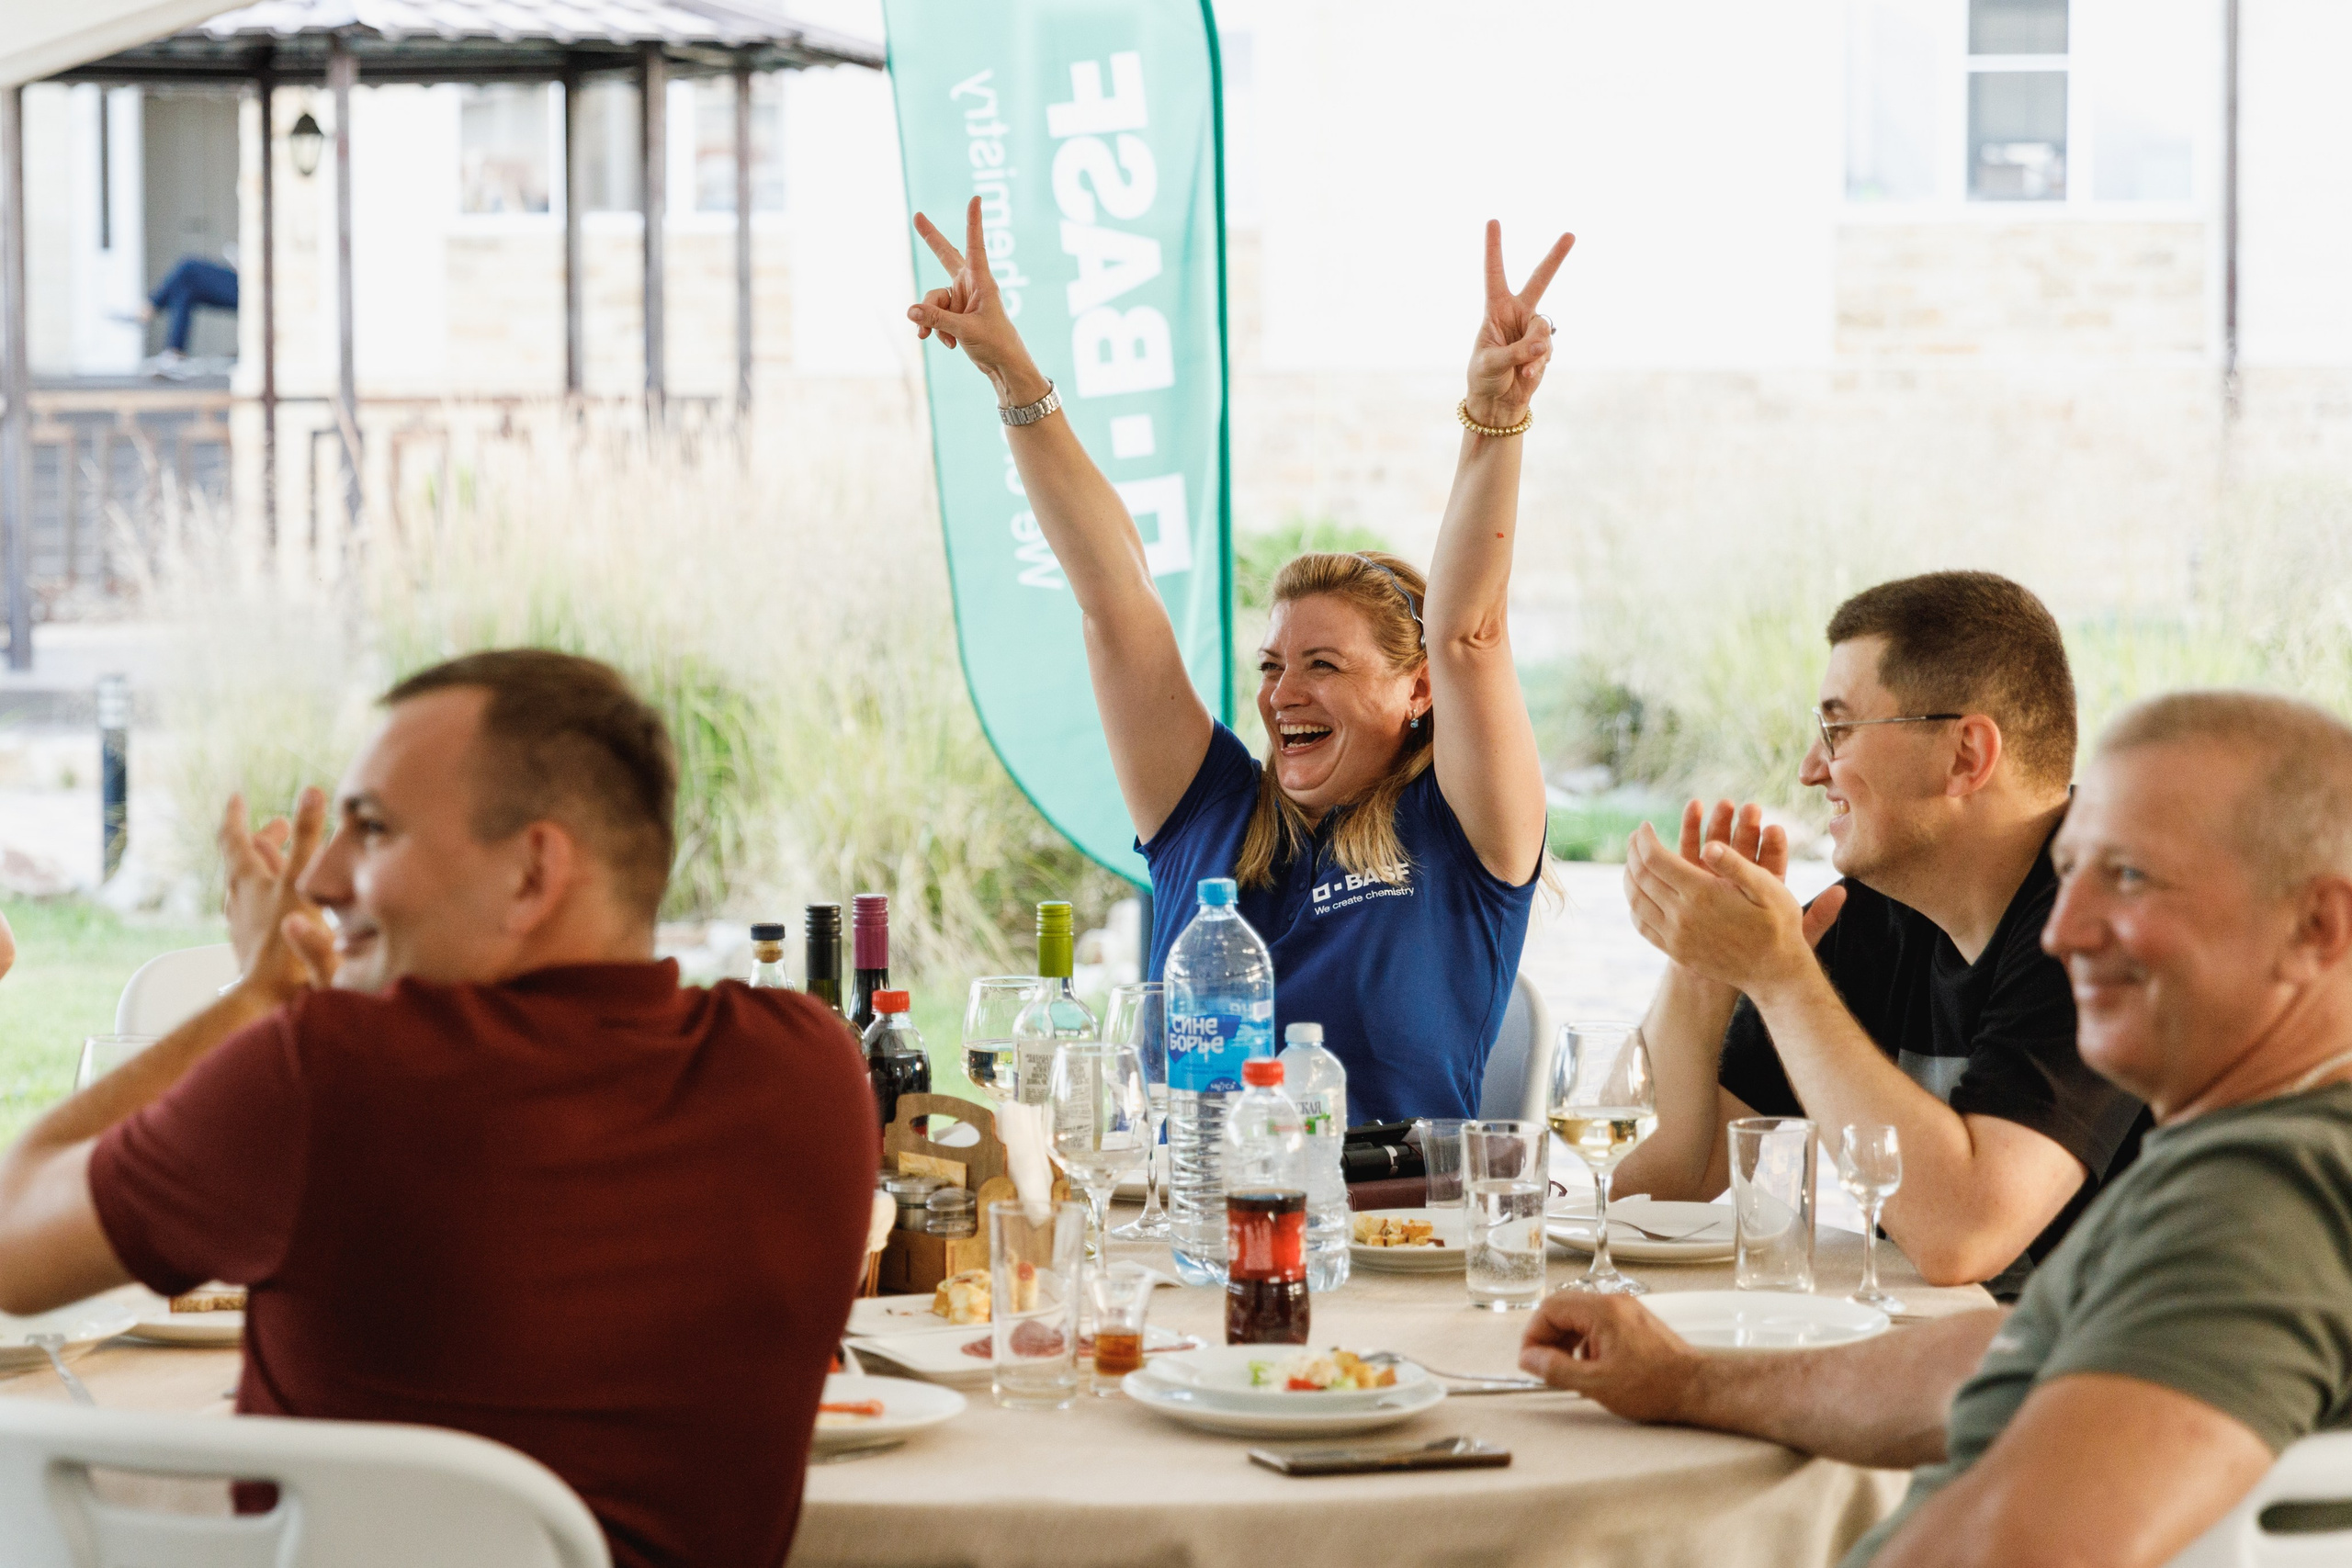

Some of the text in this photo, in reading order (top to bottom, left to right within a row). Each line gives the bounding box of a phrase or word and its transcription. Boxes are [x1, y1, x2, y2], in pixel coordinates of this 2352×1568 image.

[1345, 863, 1409, 891] BASF
[1315, 887, 1414, 915] We create chemistry
